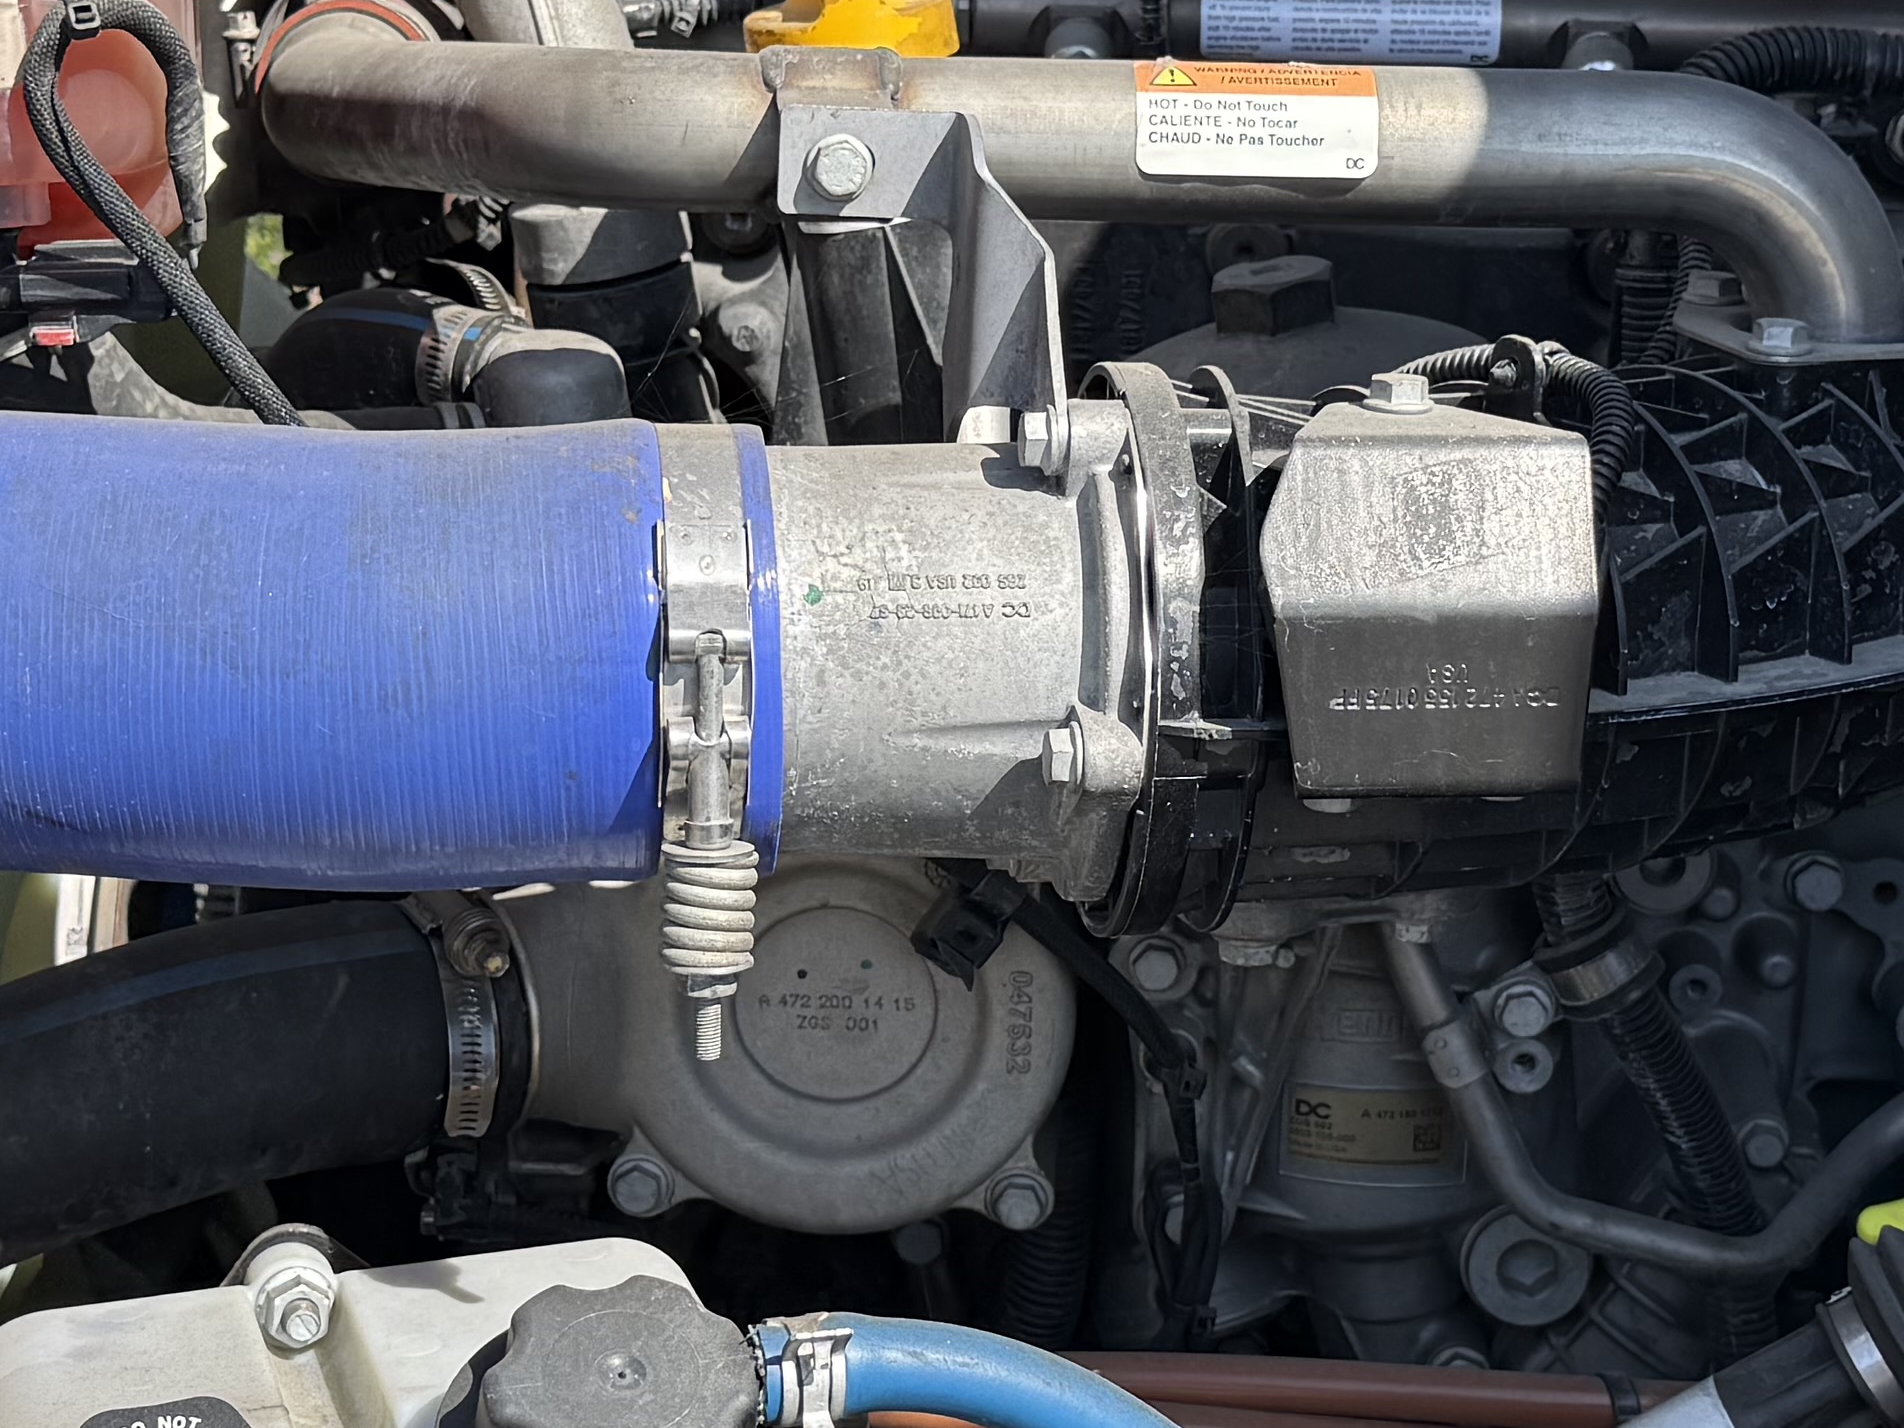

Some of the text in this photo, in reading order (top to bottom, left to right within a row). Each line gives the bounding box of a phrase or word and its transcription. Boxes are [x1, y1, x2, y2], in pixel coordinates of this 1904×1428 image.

[1228, 76, 1339, 87] AVERTISSEMENT
[1148, 98, 1180, 110] HOT
[1194, 99, 1213, 111] Do
[1217, 100, 1242, 112] Not
[1246, 100, 1288, 112] Touch
[1148, 114, 1223, 128] CALIENTE
[1236, 116, 1256, 128] No
[1261, 117, 1298, 129] Tocar
[1148, 131, 1202, 145] CHAUD
[1239, 133, 1264, 146] Pas
[1268, 134, 1325, 147] Toucher
[1346, 157, 1365, 170] DC
[776, 994, 810, 1012] 472
[864, 994, 884, 1011] 14
[1295, 1098, 1332, 1119] DC
